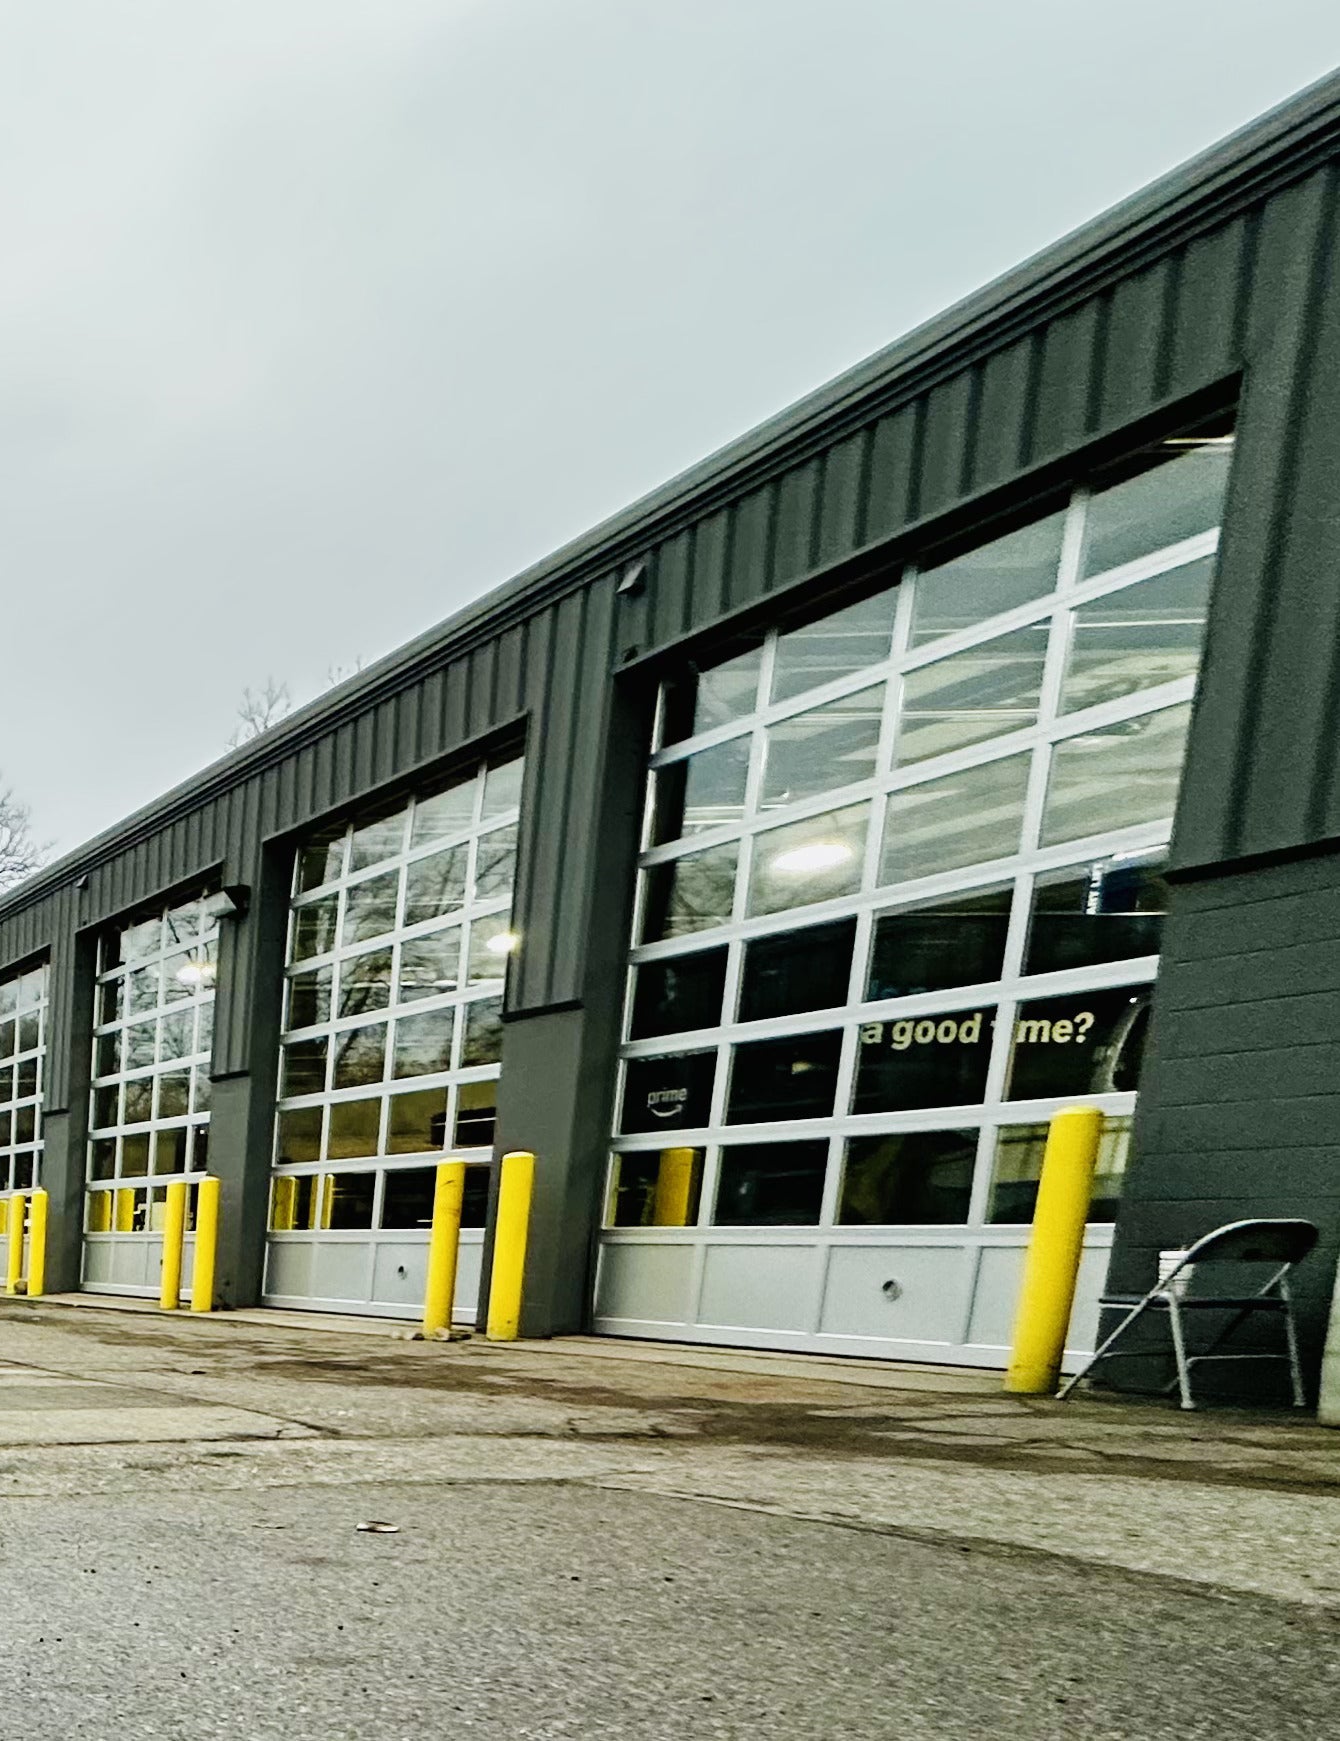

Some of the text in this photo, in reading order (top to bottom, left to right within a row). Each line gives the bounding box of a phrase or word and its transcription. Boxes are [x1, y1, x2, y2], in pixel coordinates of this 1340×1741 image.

[861, 1012, 1095, 1050] a good me?
